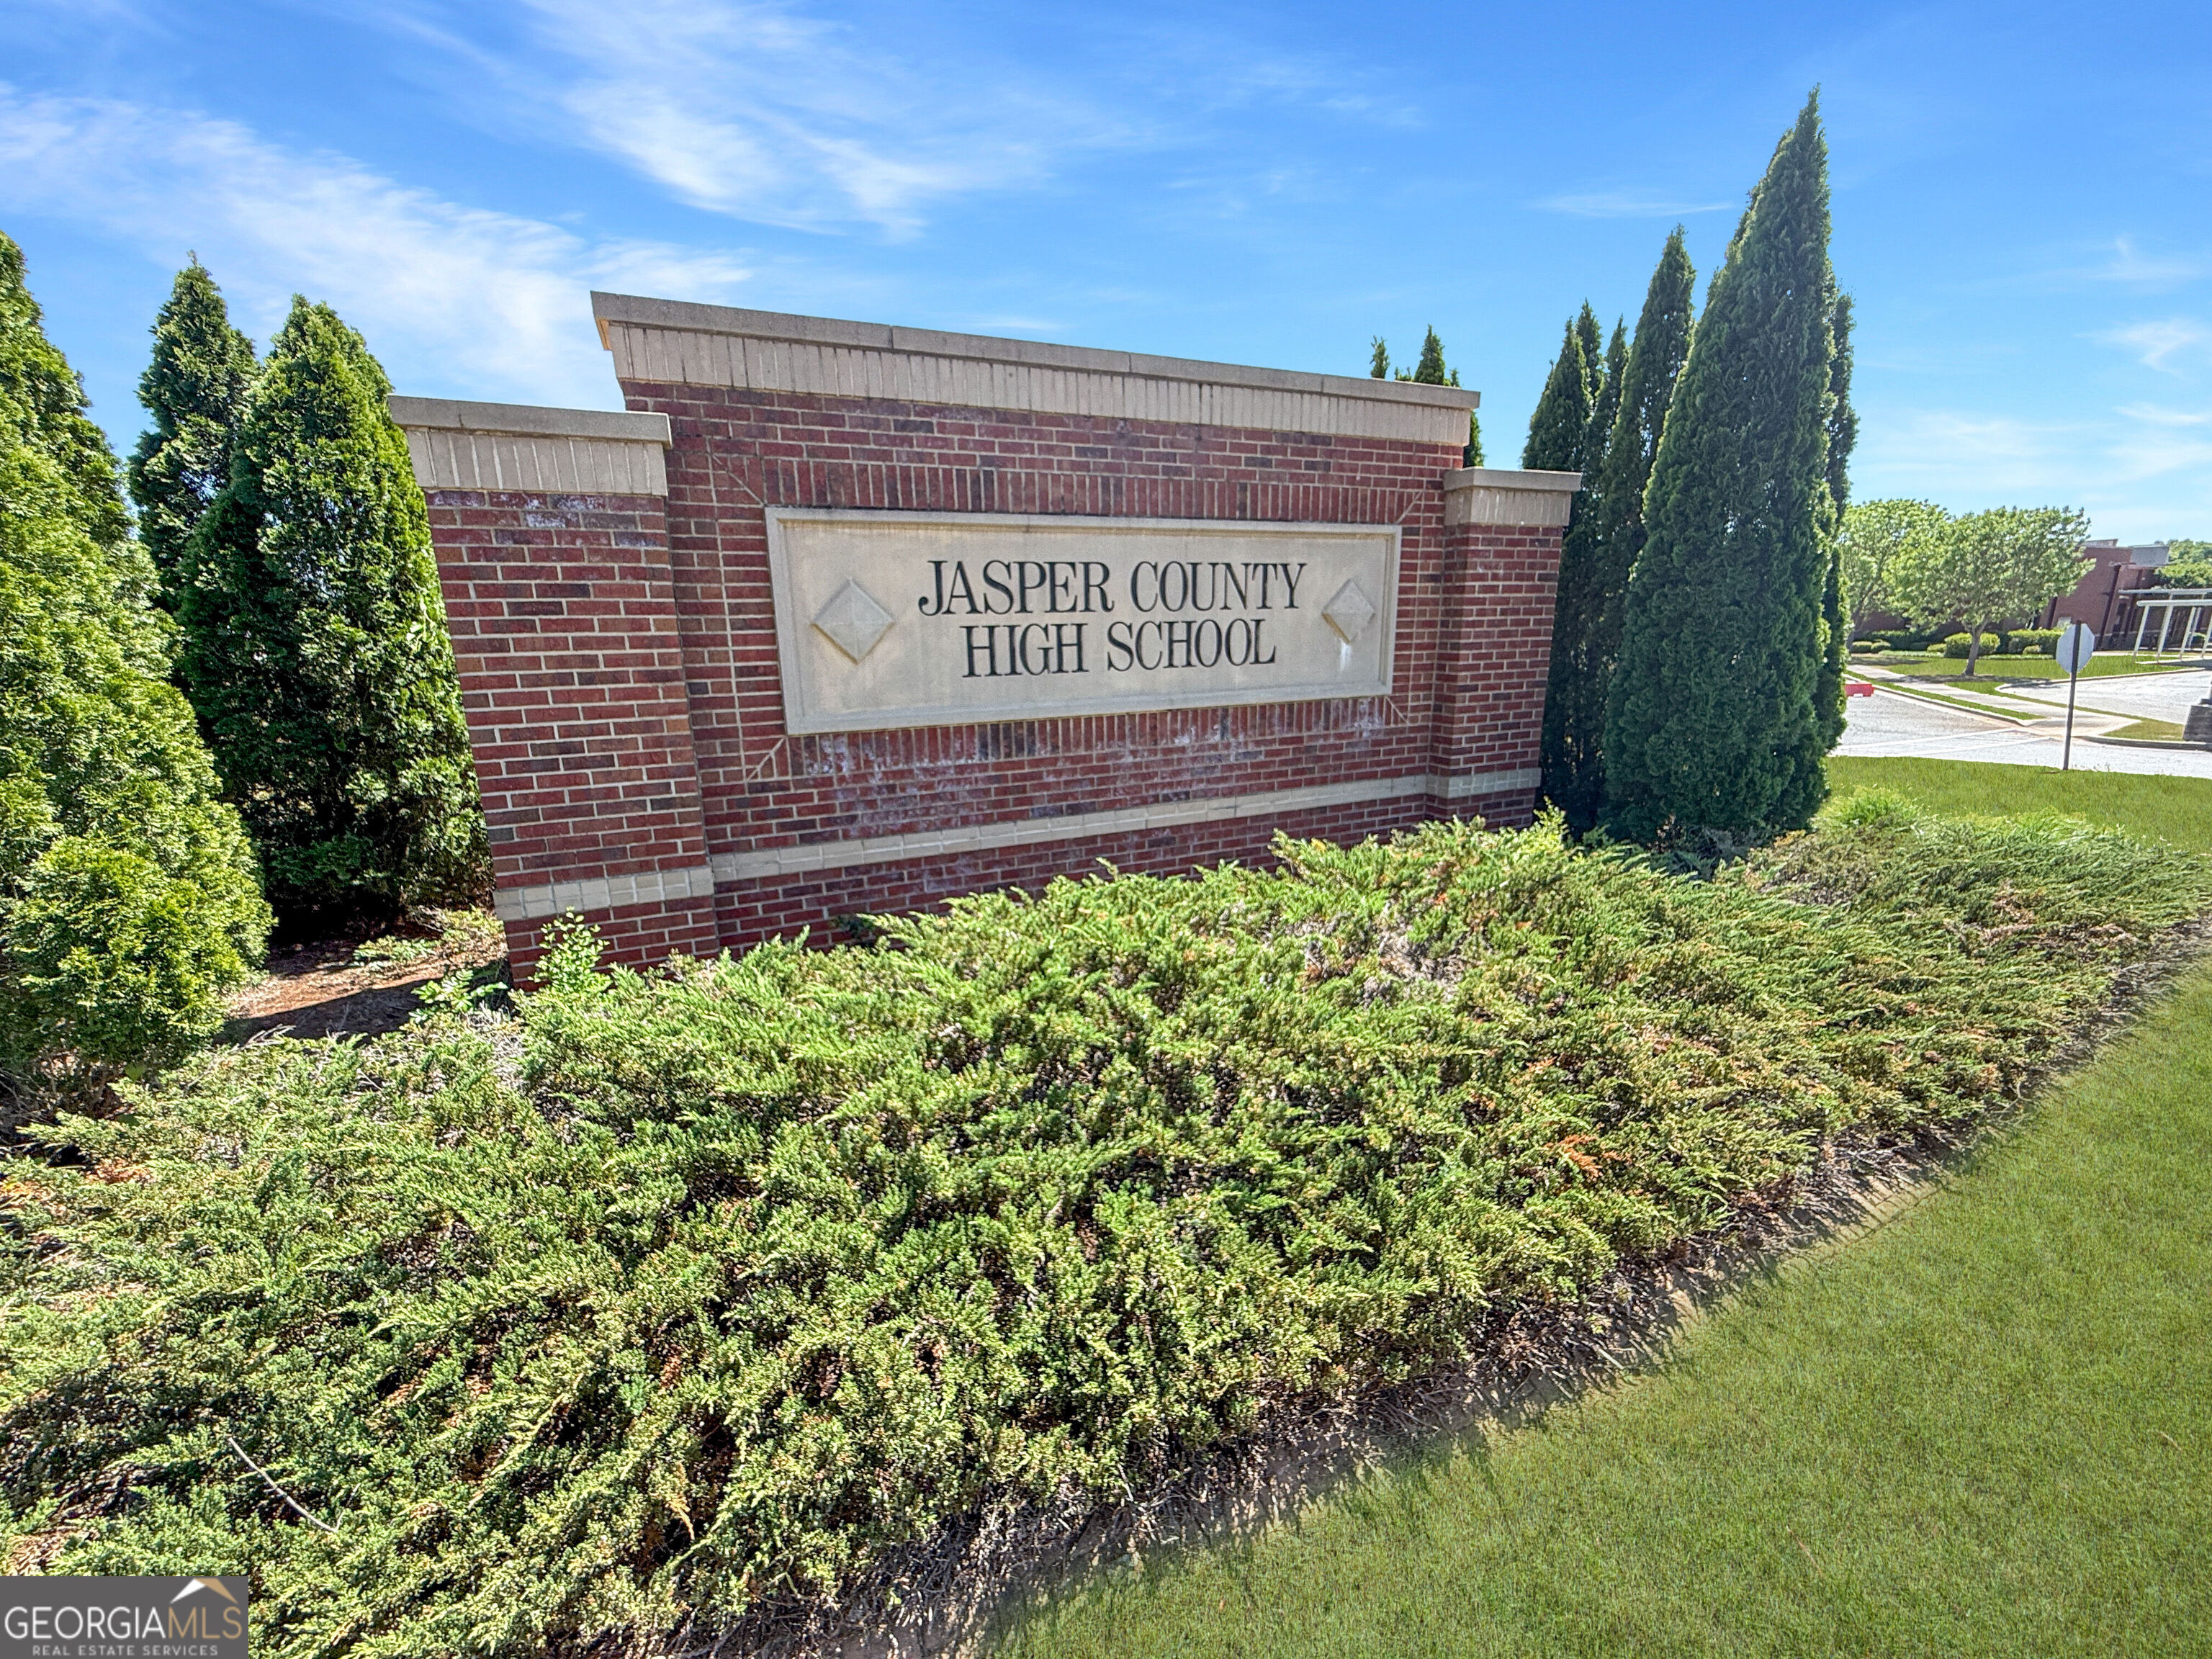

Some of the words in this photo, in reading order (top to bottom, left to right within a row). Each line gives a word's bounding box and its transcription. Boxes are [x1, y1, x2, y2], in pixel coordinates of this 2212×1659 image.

[917, 559, 1115, 616] JASPER
[1130, 561, 1308, 612] COUNTY
[962, 622, 1089, 678] HIGH
[1107, 618, 1277, 673] SCHOOL
